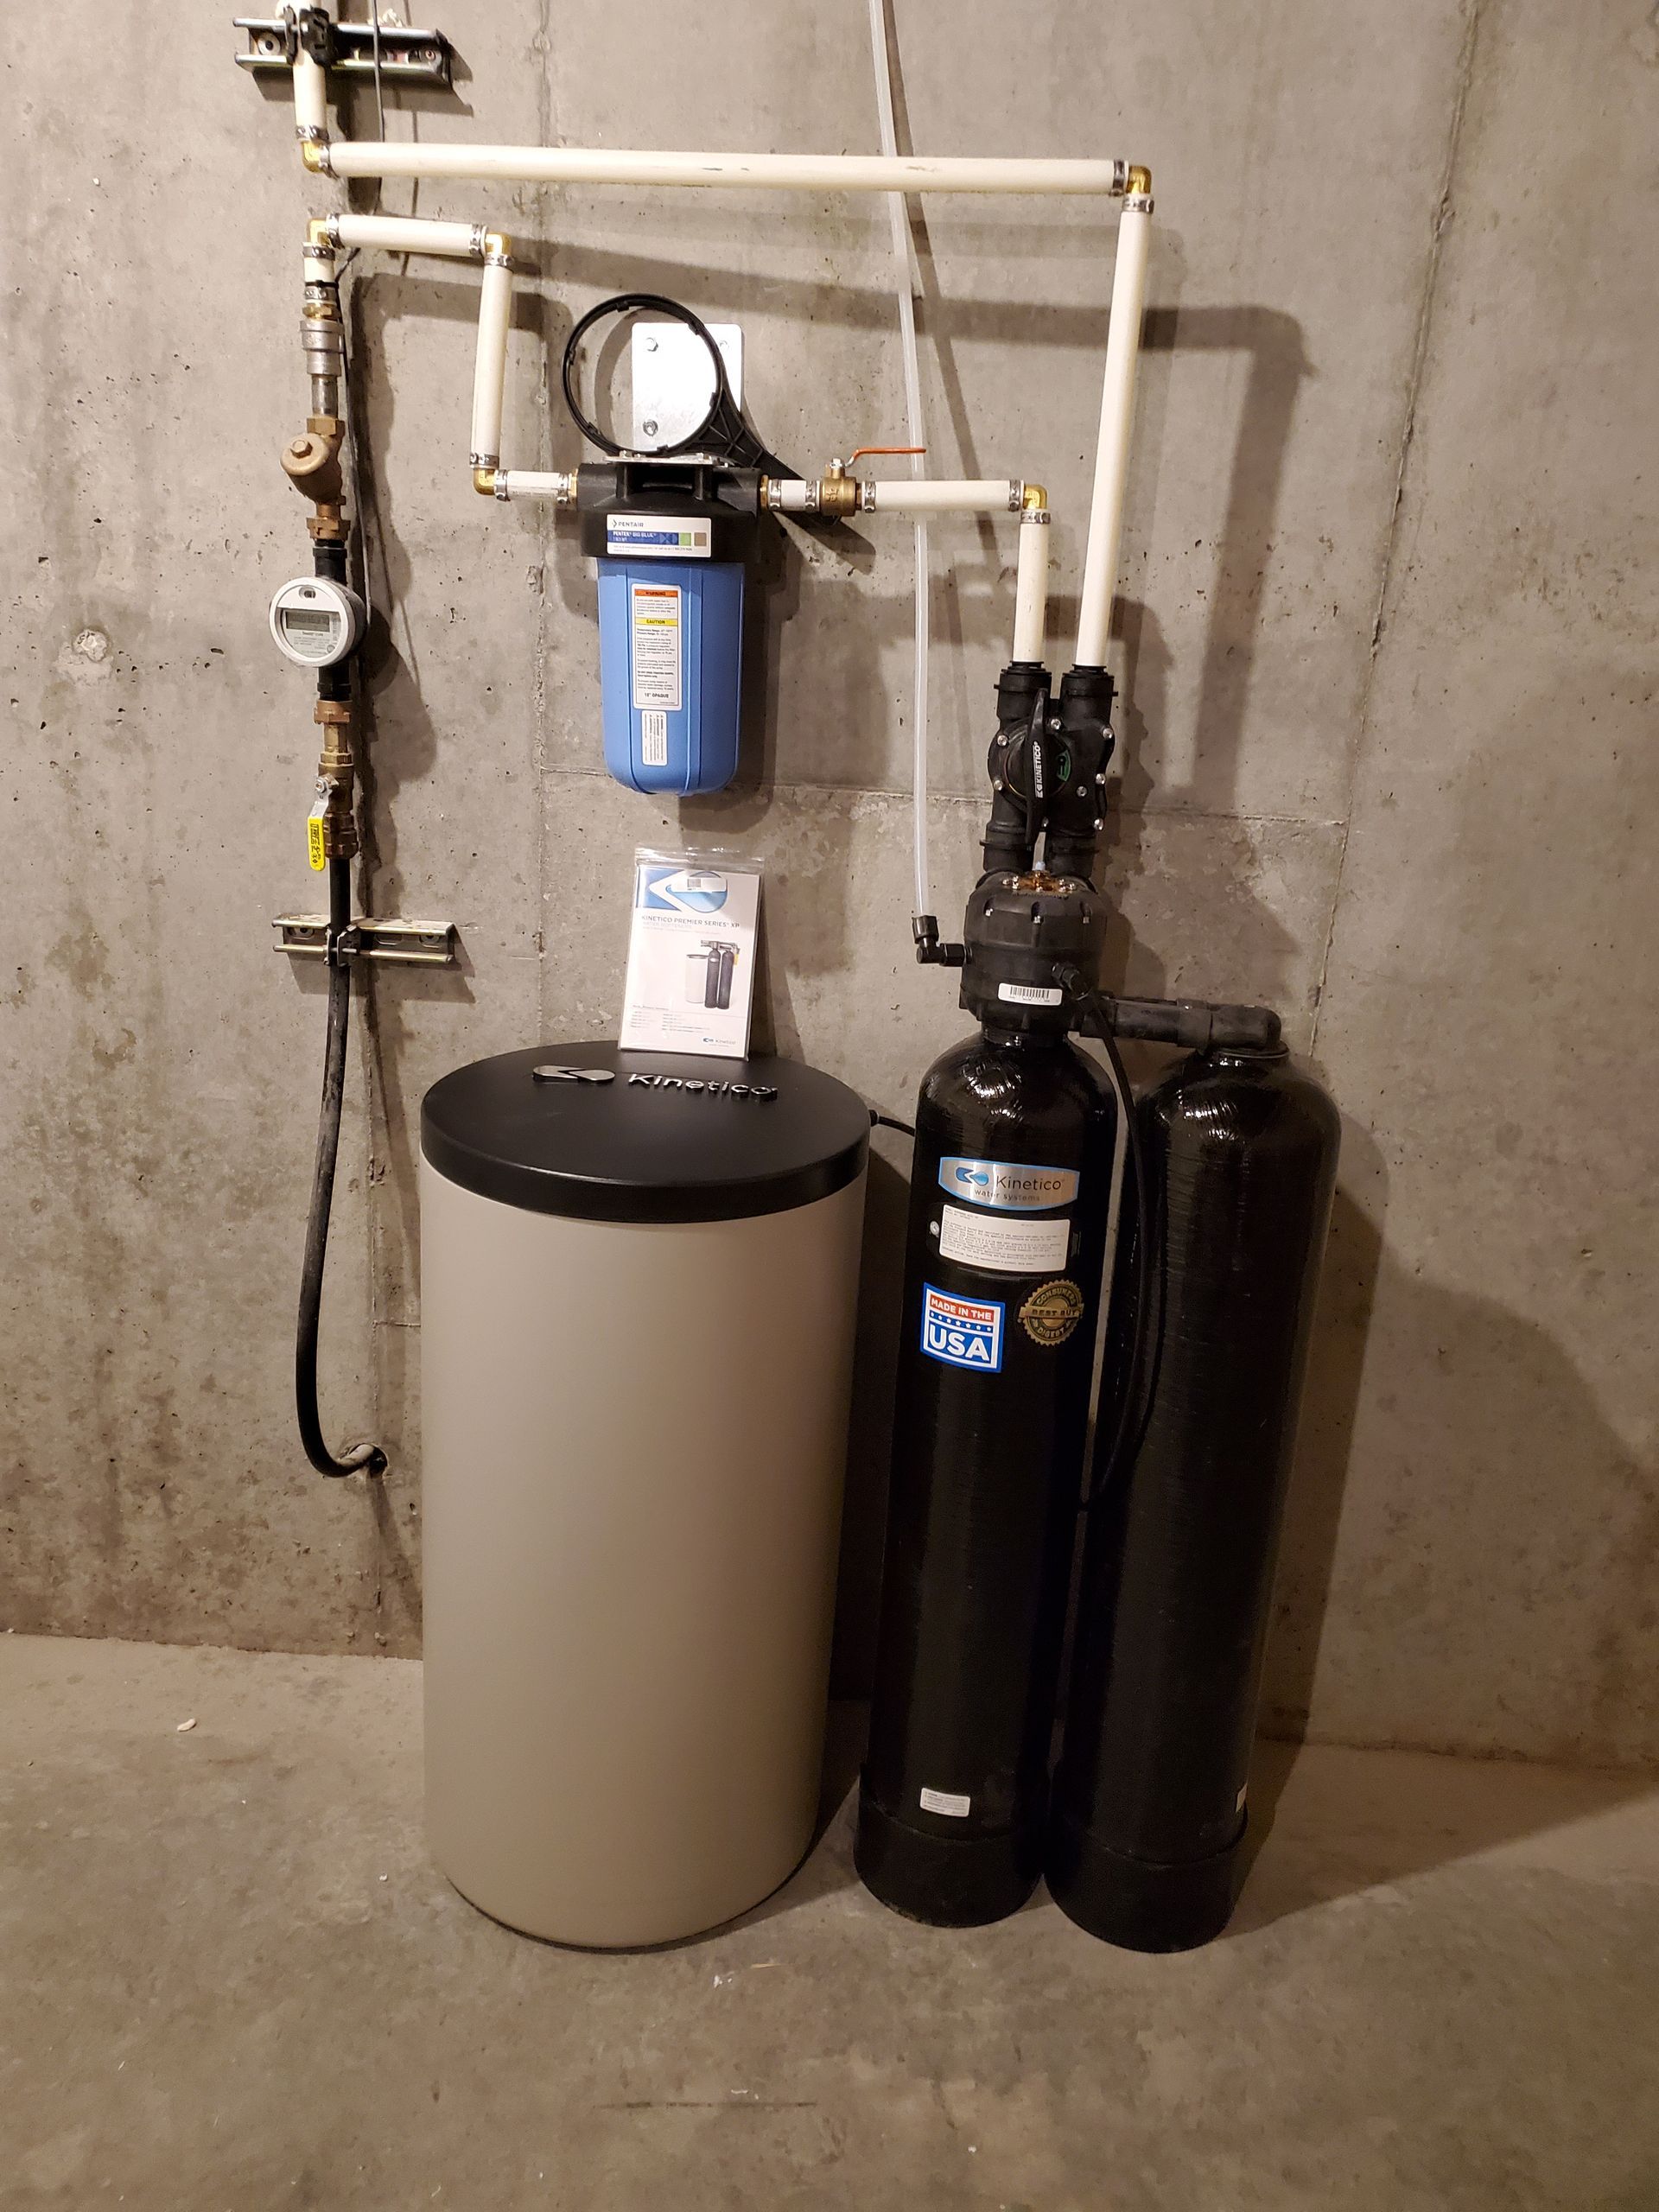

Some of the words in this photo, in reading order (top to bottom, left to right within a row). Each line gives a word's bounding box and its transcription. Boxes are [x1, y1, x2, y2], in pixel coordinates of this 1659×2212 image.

[1034, 745, 1043, 785] KINETICO
[628, 1073, 772, 1096] Kinetico
[996, 1175, 1062, 1191] Kinetico
[931, 1298, 957, 1314] MADE
[958, 1306, 969, 1318] IN
[970, 1309, 992, 1321] THE
[929, 1323, 990, 1362] USA
[1037, 1326, 1065, 1338] DIGEST
